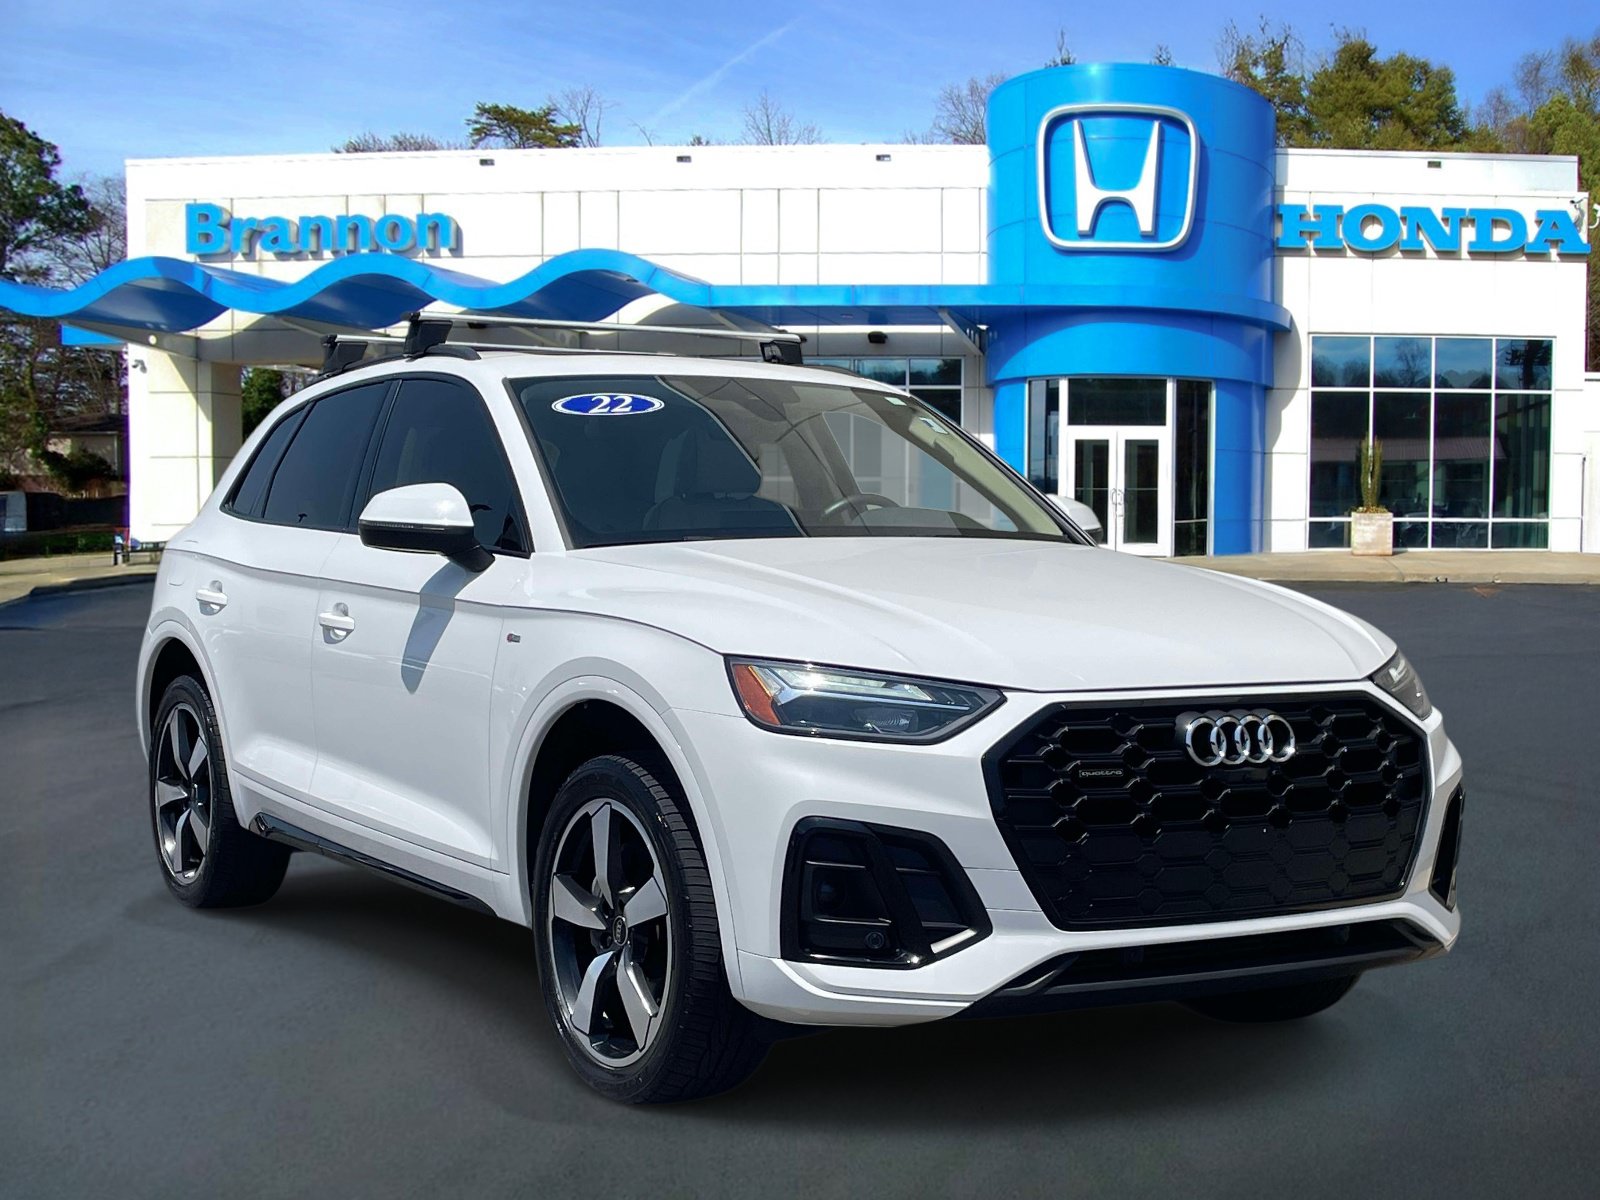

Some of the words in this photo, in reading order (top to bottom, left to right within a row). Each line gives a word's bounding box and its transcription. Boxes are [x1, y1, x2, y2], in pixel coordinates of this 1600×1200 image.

[185, 202, 454, 255] Brannon
[1276, 203, 1592, 255] HONDA
[588, 395, 633, 414] 22
[1081, 769, 1123, 778] quattro
